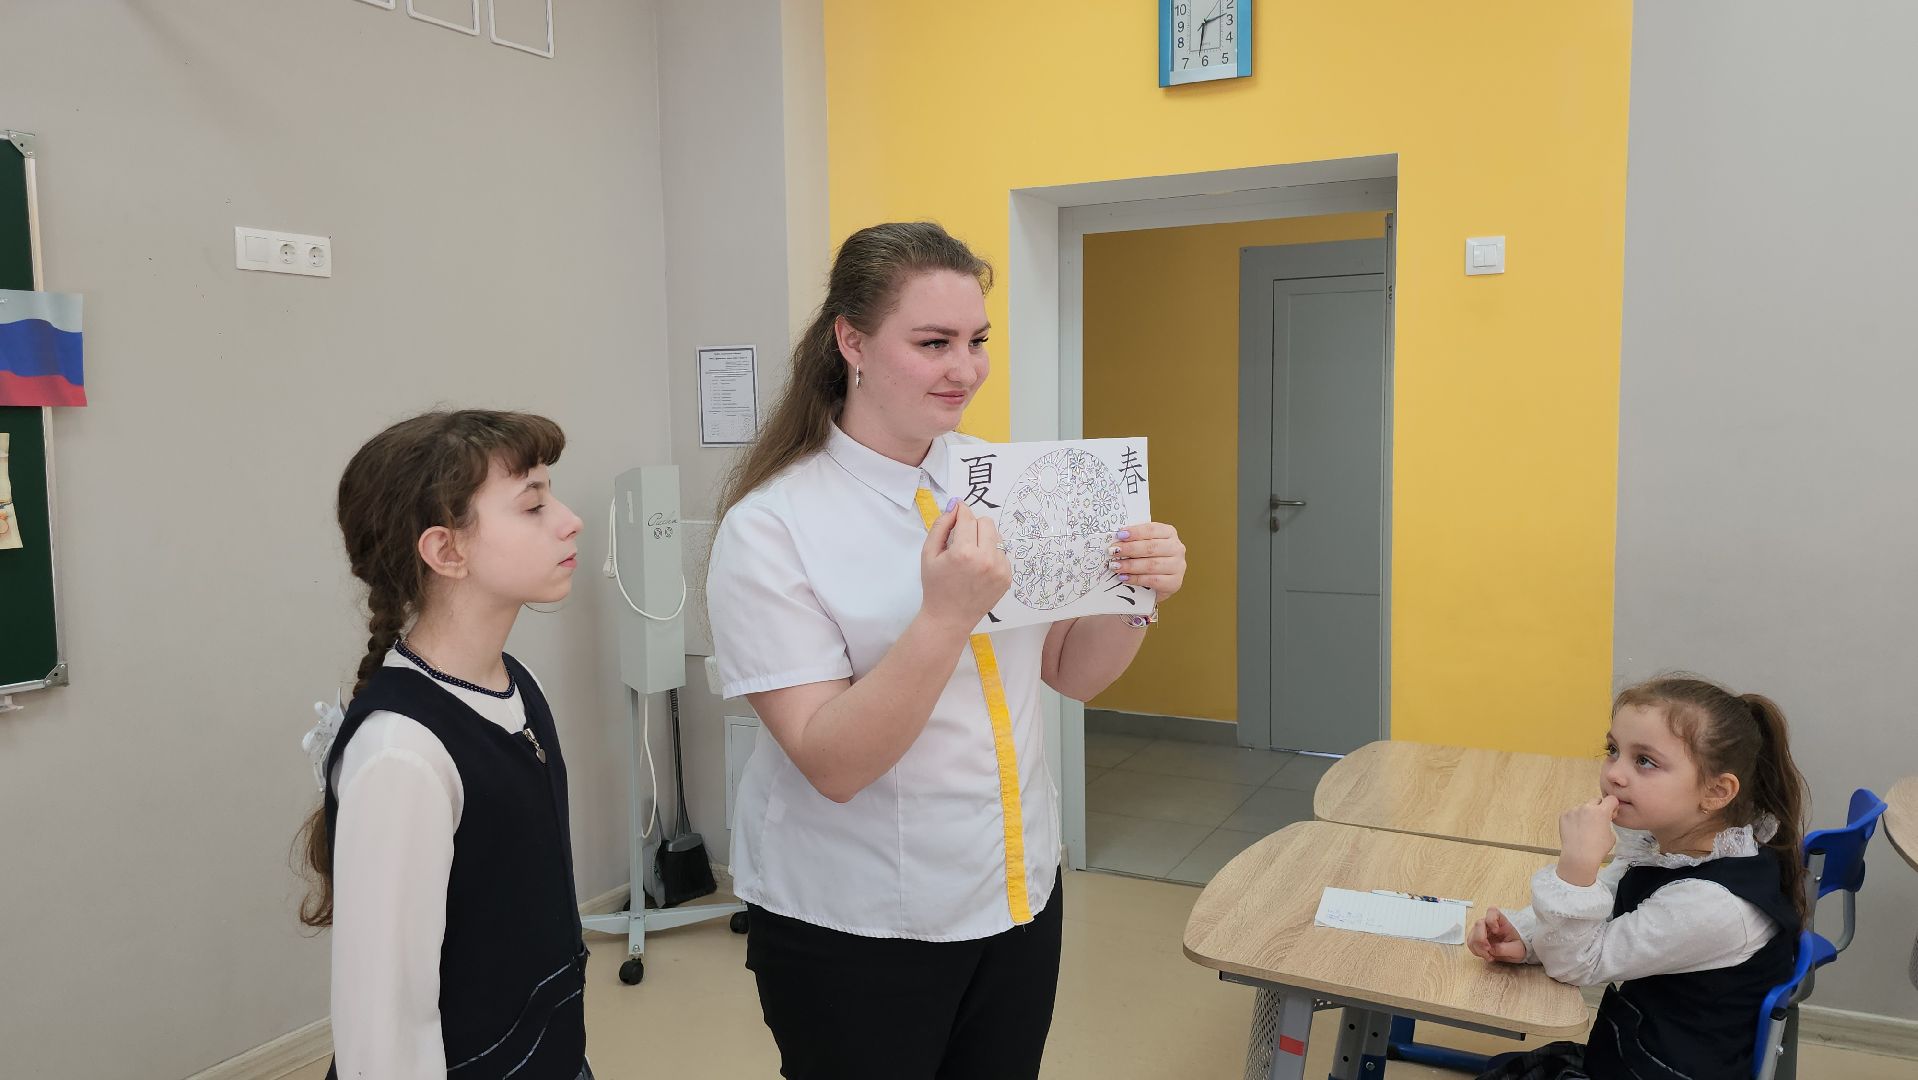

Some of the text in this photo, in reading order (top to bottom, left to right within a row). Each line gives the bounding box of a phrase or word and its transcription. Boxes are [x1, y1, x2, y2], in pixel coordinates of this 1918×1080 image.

[1175, 4, 1187, 16] 10
[1226, 0, 1234, 9] 2
[1225, 14, 1234, 26] 3
[1177, 21, 1185, 33] 9
[1177, 37, 1185, 48] 8
[1226, 31, 1234, 43] 4
[1182, 57, 1189, 69] 7
[1201, 55, 1209, 67] 6
[1221, 52, 1229, 65] 5
[1118, 445, 1147, 495] 春
[959, 453, 1001, 509] 夏
